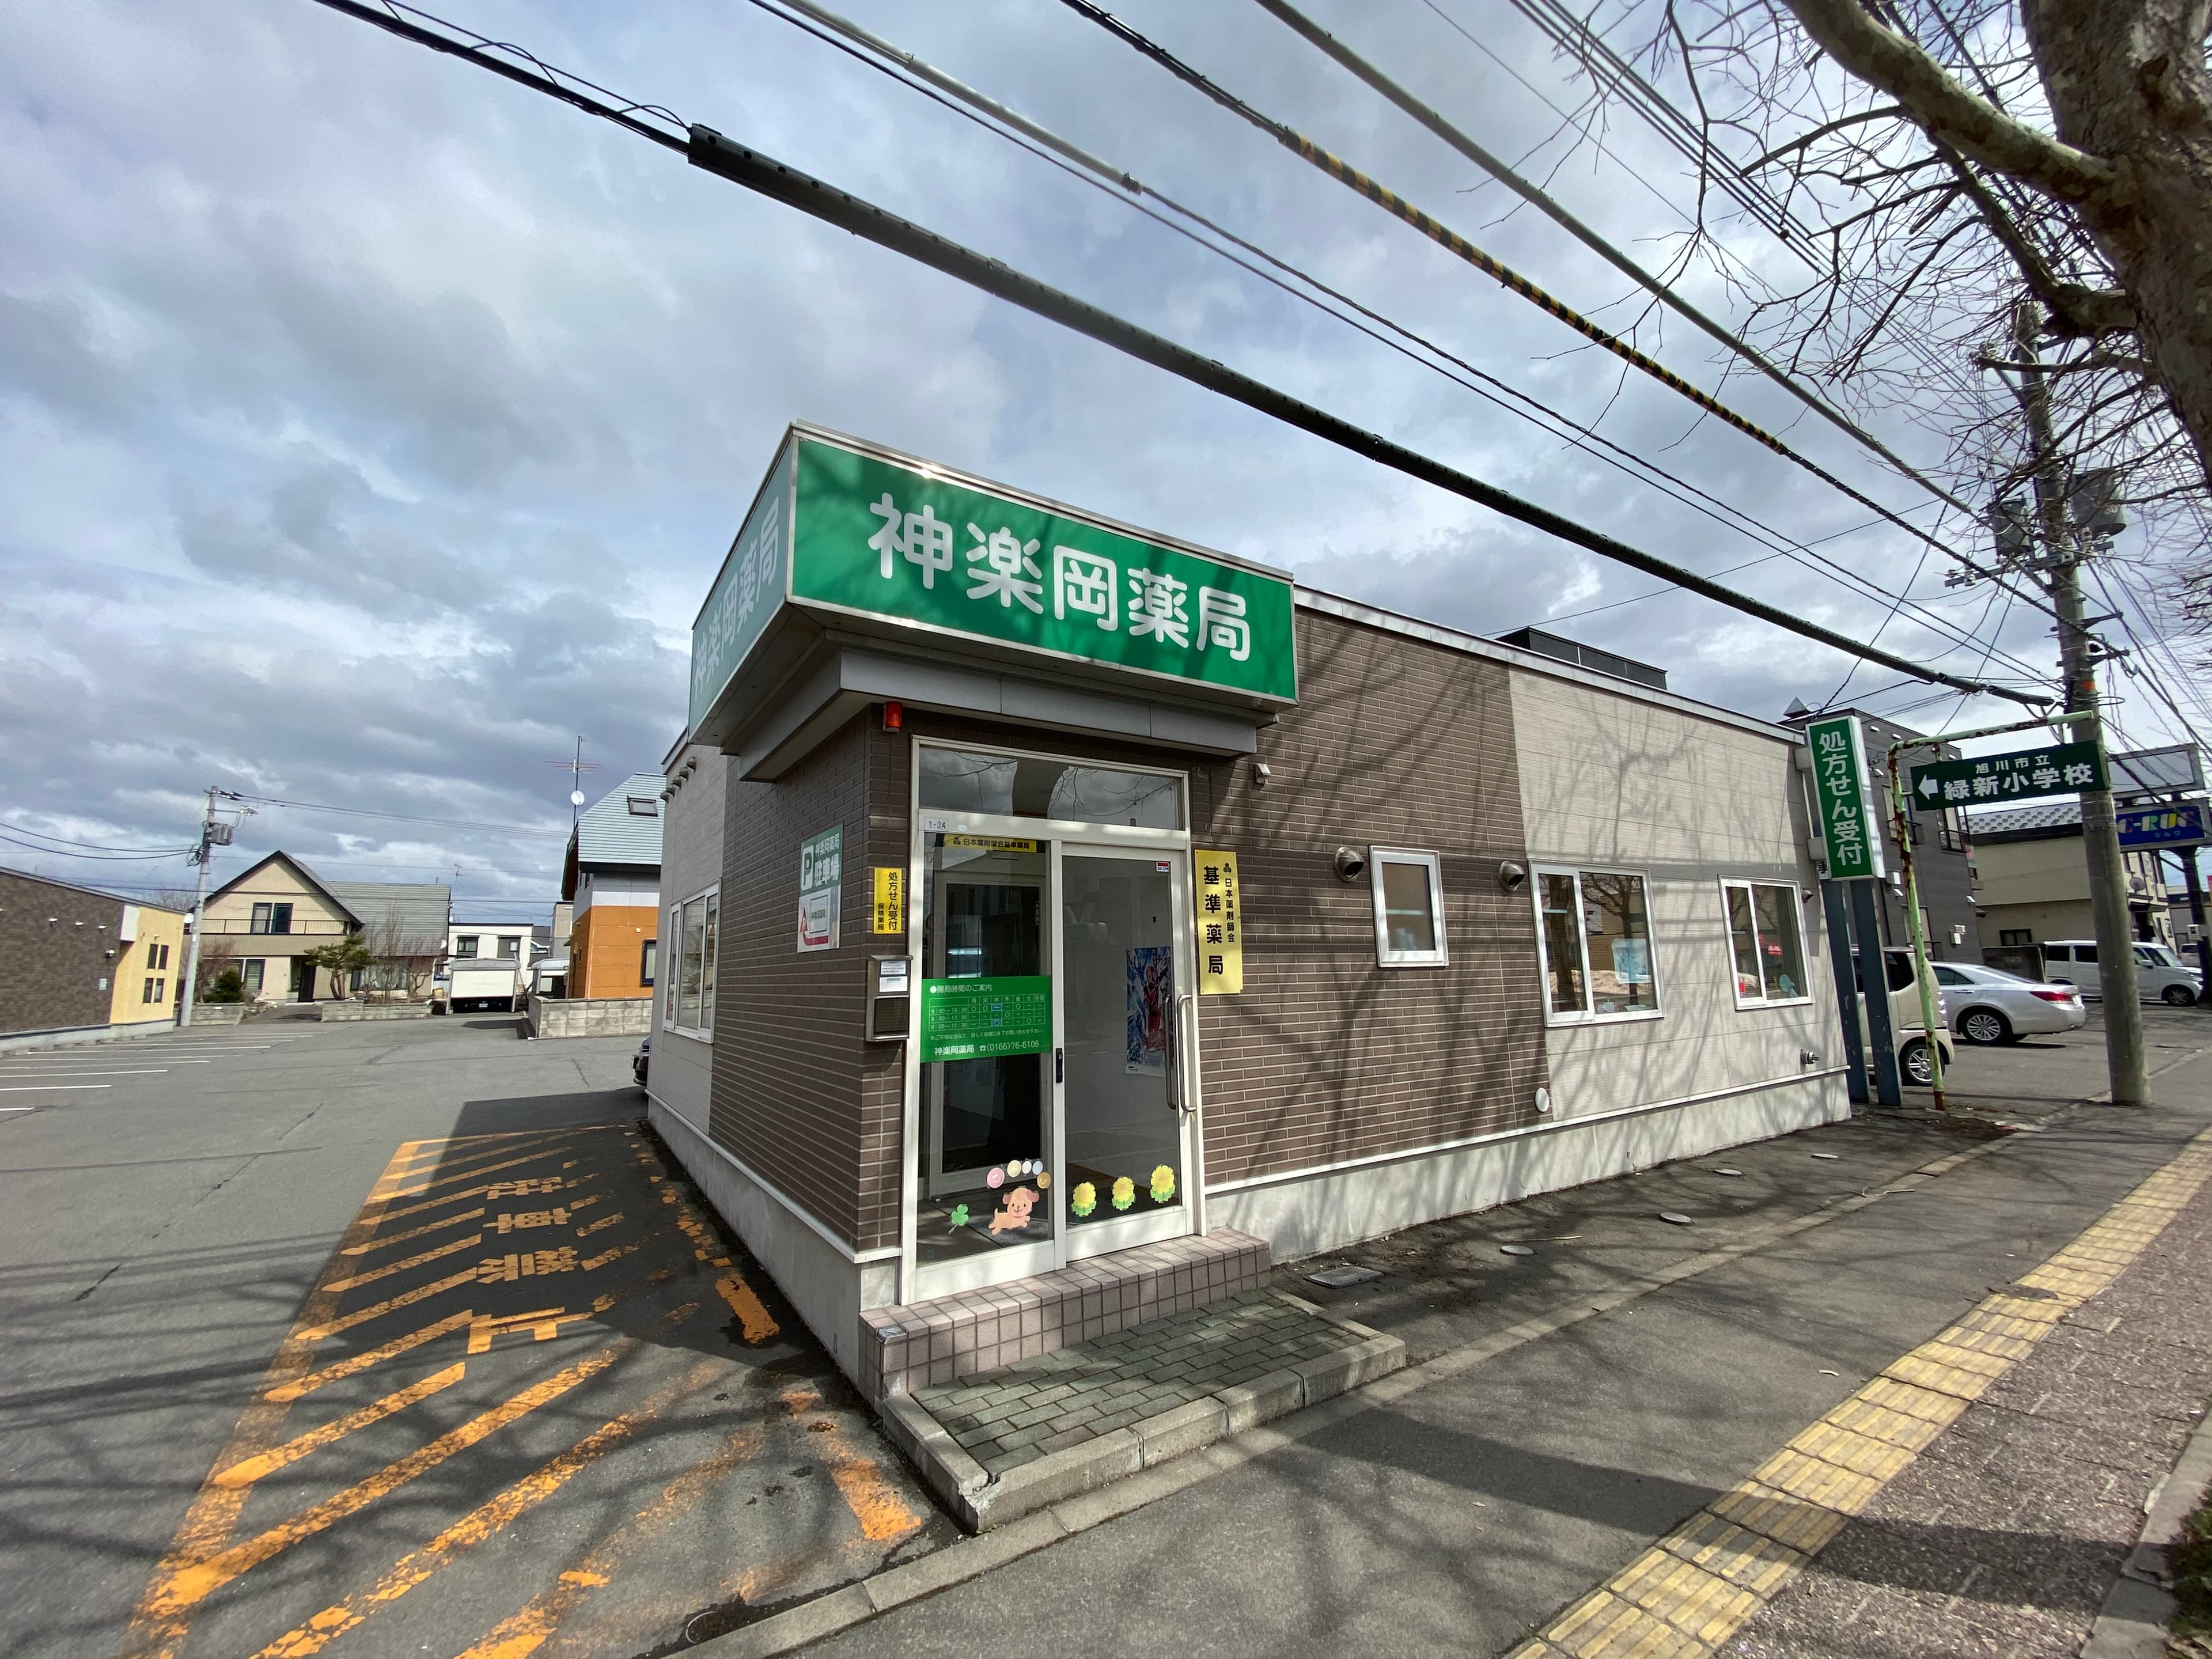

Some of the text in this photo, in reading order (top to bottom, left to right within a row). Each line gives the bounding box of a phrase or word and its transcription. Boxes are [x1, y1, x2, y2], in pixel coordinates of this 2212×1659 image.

[695, 496, 779, 701] 神楽岡薬局
[868, 493, 1251, 661] 神楽岡薬局
[1944, 763, 2093, 800] 緑新小学校
[1975, 755, 2050, 774] 旭川市立
[1819, 731, 1862, 865] 処方せん受付
[814, 853, 839, 887] 駐車場
[888, 872, 898, 931] 処方せん受付
[1203, 866, 1224, 975] 基準薬局
[1225, 878, 1235, 942] 日本薬剤師会
